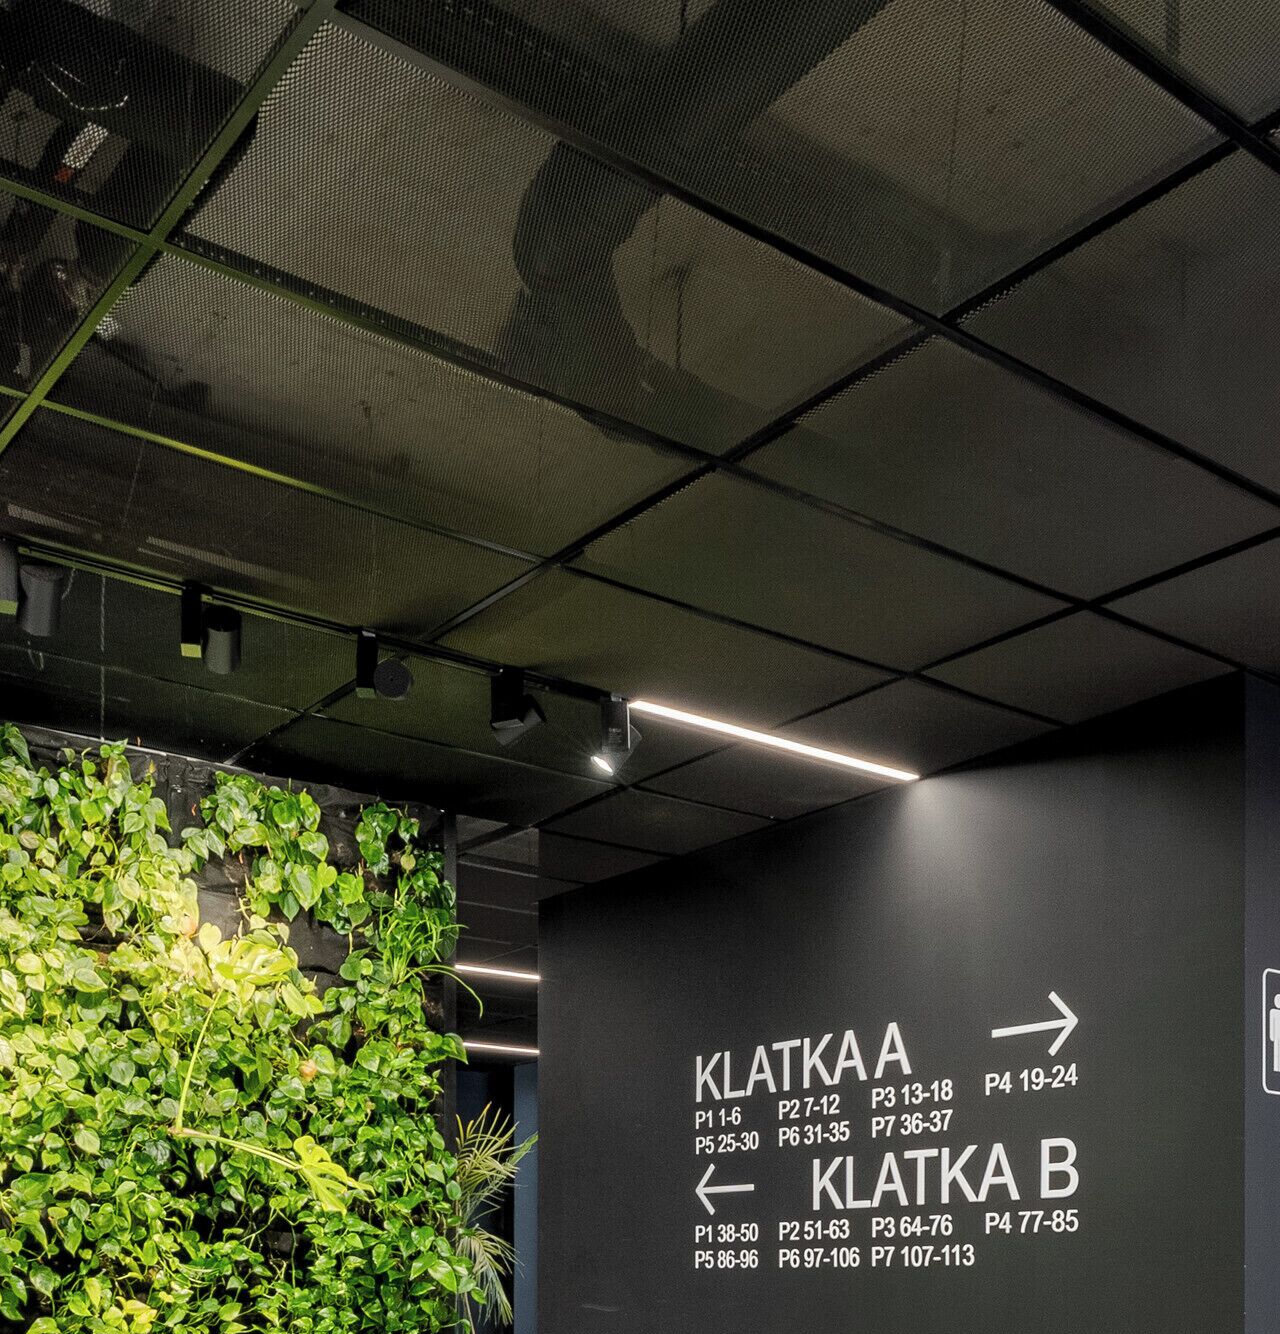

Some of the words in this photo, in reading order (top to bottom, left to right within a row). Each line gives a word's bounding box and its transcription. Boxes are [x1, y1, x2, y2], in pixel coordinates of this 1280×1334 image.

[695, 1029, 868, 1103] KLATKA
[873, 1021, 913, 1079] A
[695, 1109, 714, 1130] P1
[718, 1106, 742, 1127] 1-6
[778, 1097, 801, 1121] P2
[803, 1093, 841, 1118] 7-12
[871, 1086, 897, 1110] P3
[900, 1078, 954, 1106] 13-18
[985, 1071, 1013, 1096] P4
[1018, 1062, 1079, 1092] 19-24
[695, 1135, 715, 1155] P5
[717, 1130, 760, 1154] 25-30
[778, 1124, 801, 1148] P6
[803, 1120, 851, 1146] 31-35
[871, 1114, 897, 1139] P7
[900, 1108, 954, 1136] 36-37
[812, 1142, 1021, 1211] KLATKA
[1039, 1137, 1080, 1199] B
[694, 1224, 713, 1244] P1
[717, 1222, 759, 1243] 38-50
[778, 1220, 801, 1242] P2
[803, 1218, 851, 1241] 51-63
[871, 1216, 897, 1239] P3
[899, 1213, 954, 1238] 64-76
[985, 1211, 1013, 1235] P4
[1017, 1208, 1079, 1234] 77-85
[694, 1250, 715, 1269] P5
[716, 1248, 759, 1269] 86-96
[778, 1248, 801, 1269] P6
[803, 1246, 861, 1268] 97-106
[871, 1244, 896, 1268] P7
[900, 1243, 976, 1268] 107-113
